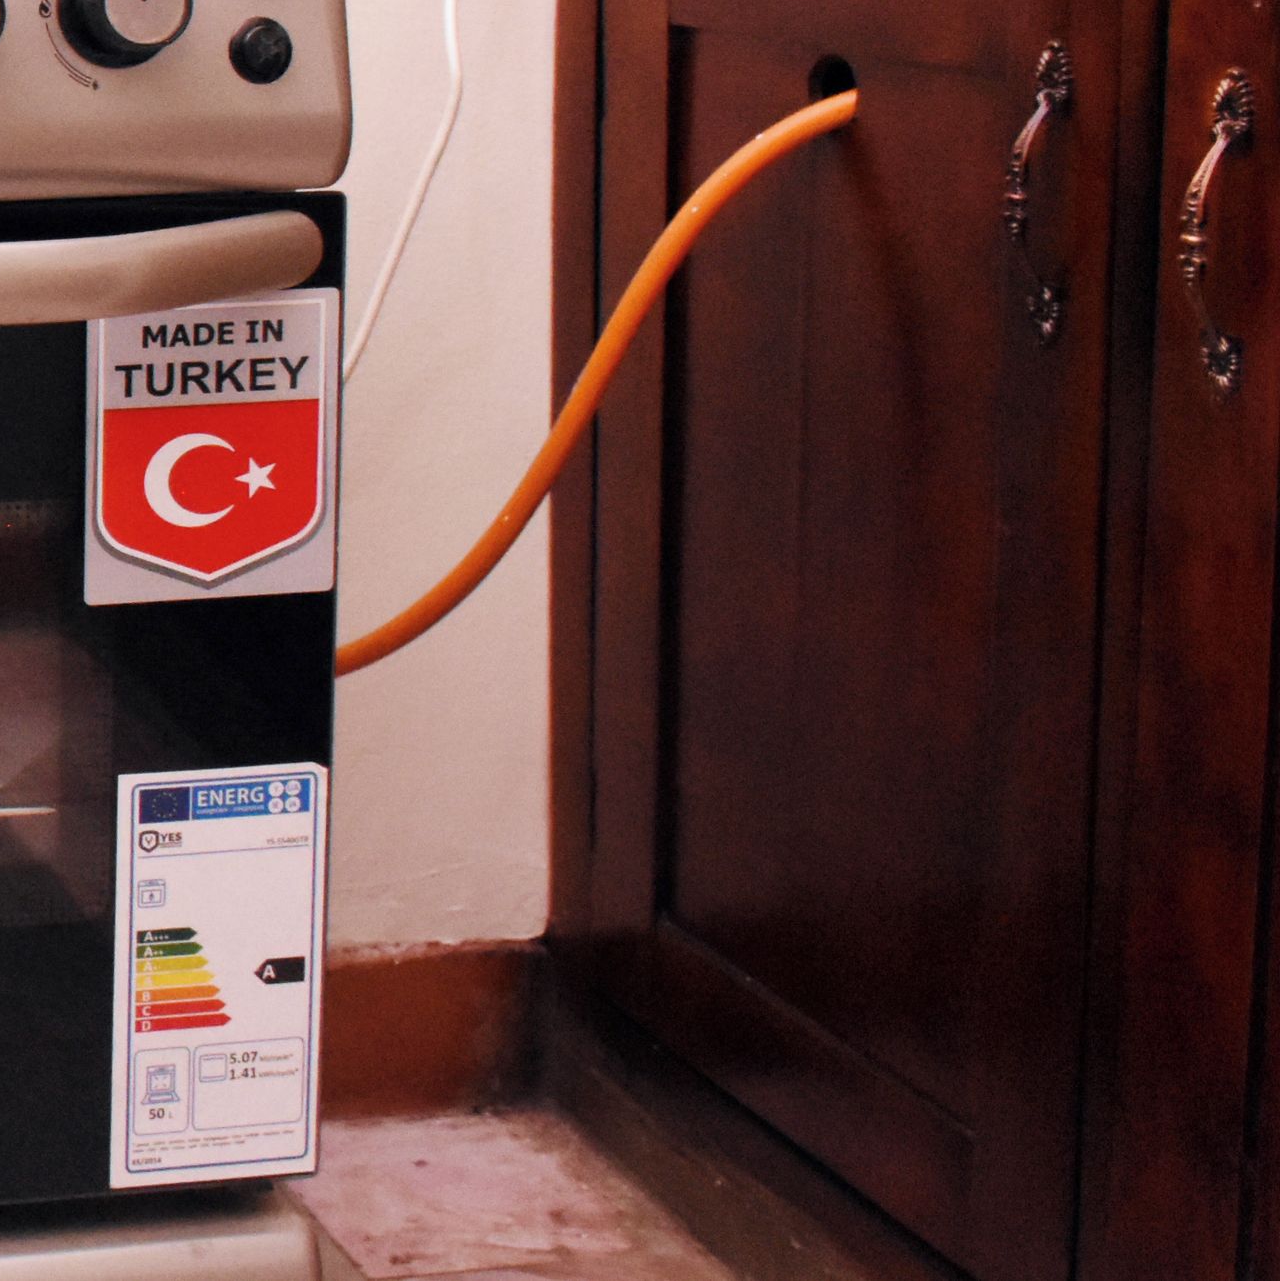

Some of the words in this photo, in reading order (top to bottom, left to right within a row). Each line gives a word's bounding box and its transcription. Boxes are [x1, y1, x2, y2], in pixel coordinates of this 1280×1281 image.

[141, 321, 235, 349] MADE
[245, 319, 284, 344] IN
[114, 355, 310, 398] TURKEY
[197, 786, 264, 807] ENERG
[160, 832, 183, 842] YES
[262, 964, 277, 979] A
[142, 991, 151, 1002] B
[142, 1005, 152, 1017] C
[142, 1020, 152, 1032] D
[229, 1051, 258, 1064] 5.07
[230, 1067, 257, 1080] 1.41
[149, 1108, 165, 1120] 50
